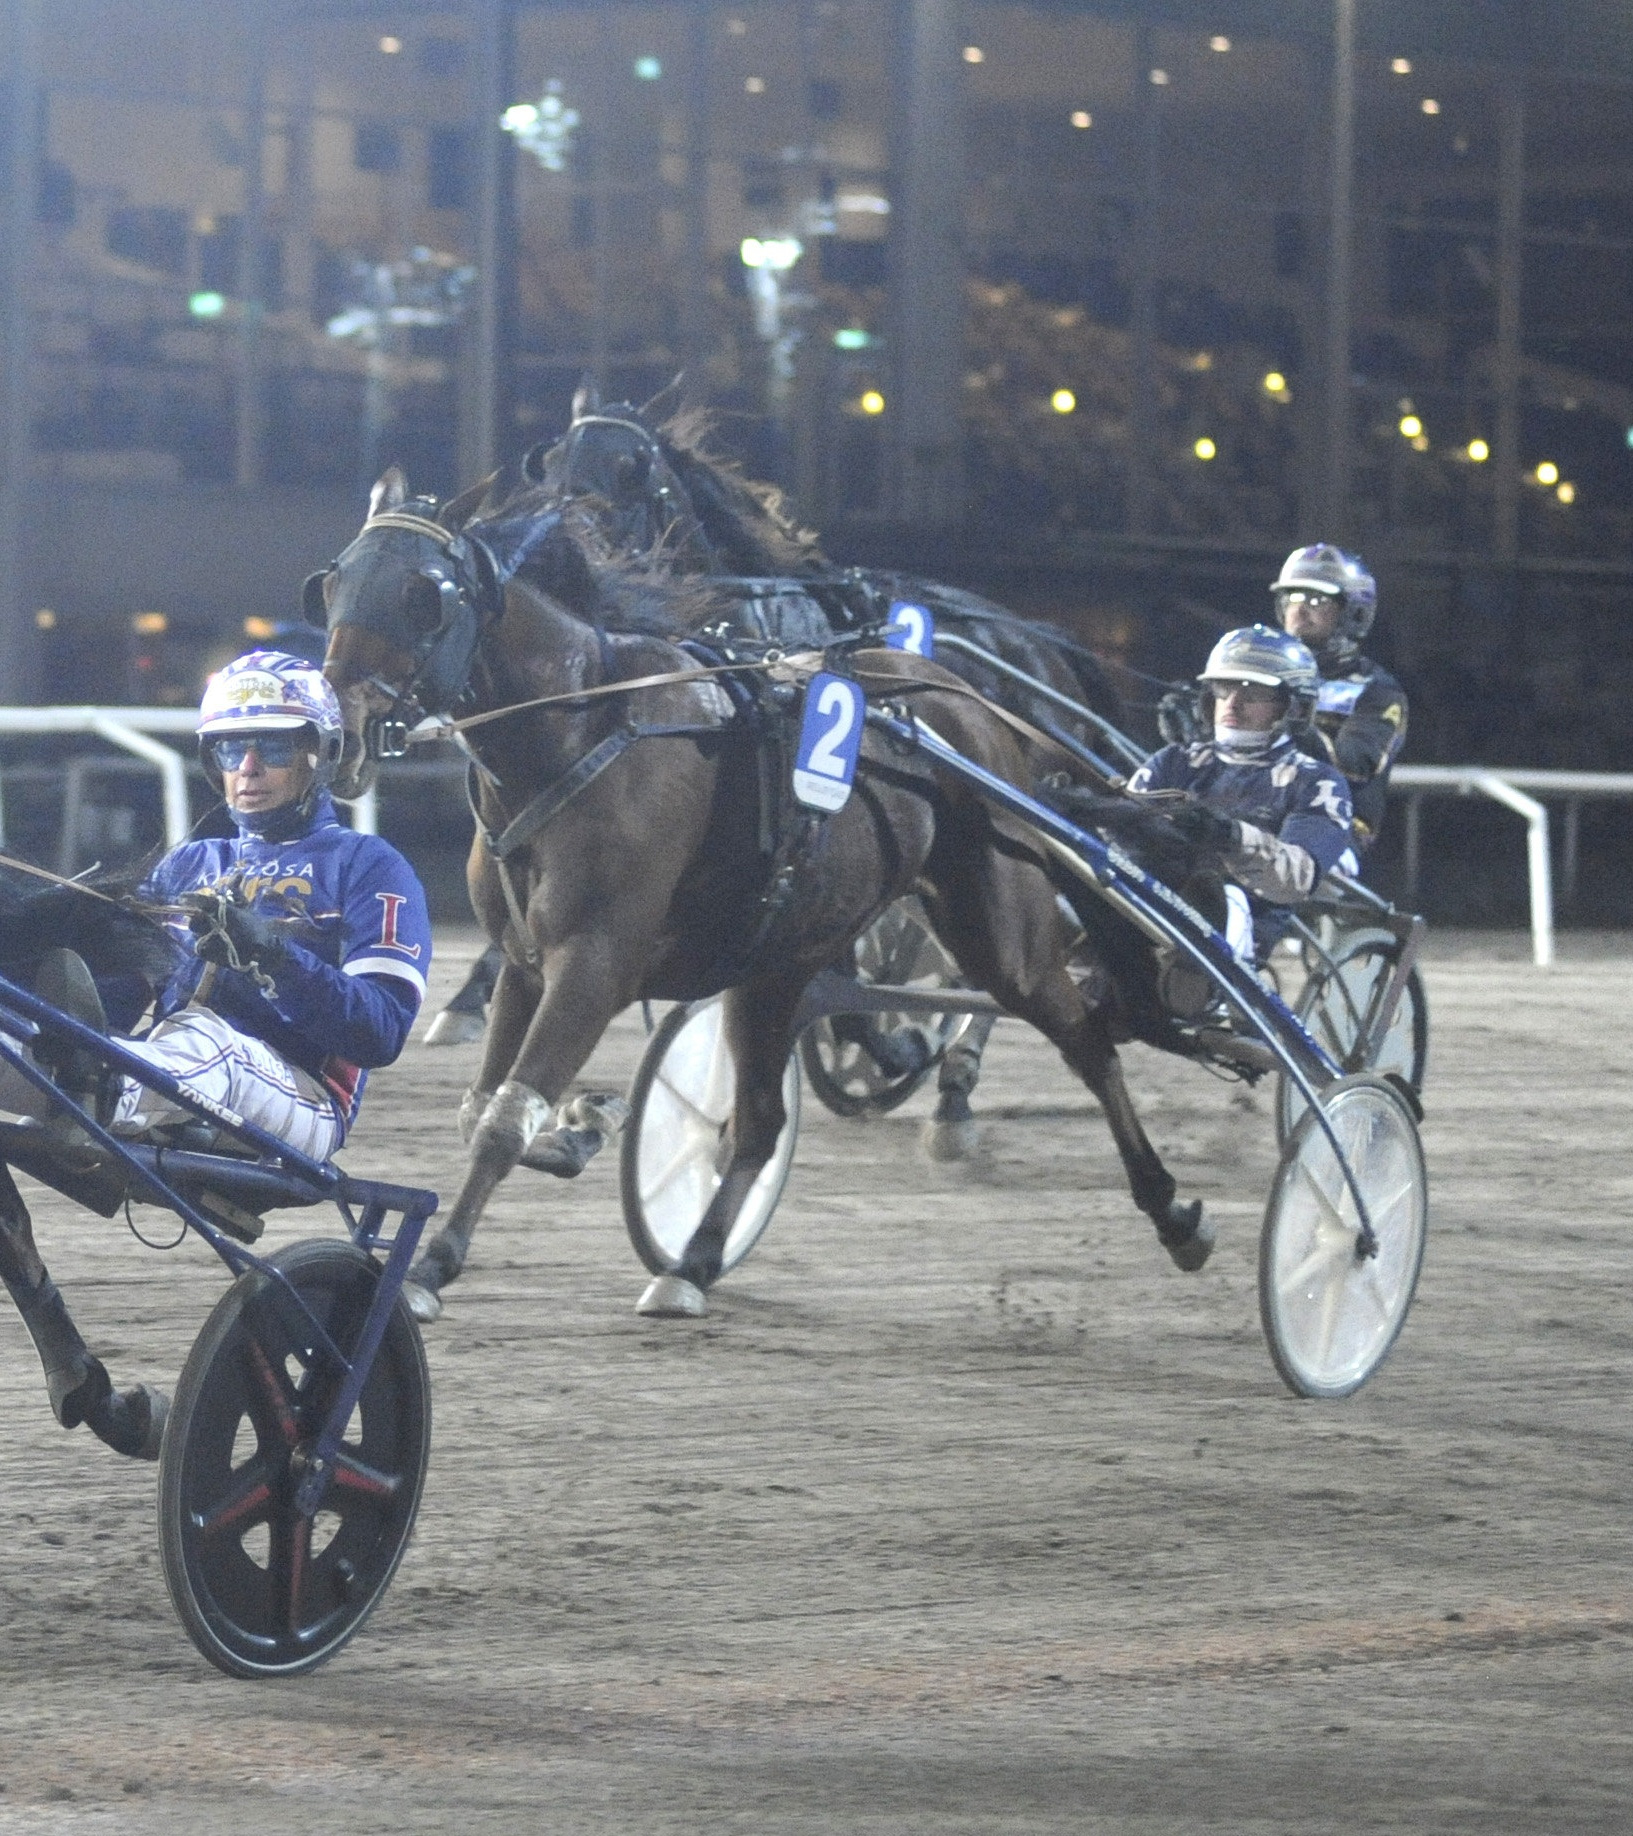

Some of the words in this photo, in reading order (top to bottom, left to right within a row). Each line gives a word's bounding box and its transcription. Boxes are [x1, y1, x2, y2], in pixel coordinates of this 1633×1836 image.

[807, 682, 855, 778] 2
[371, 893, 421, 959] L
[177, 1080, 244, 1127] YANKEE
